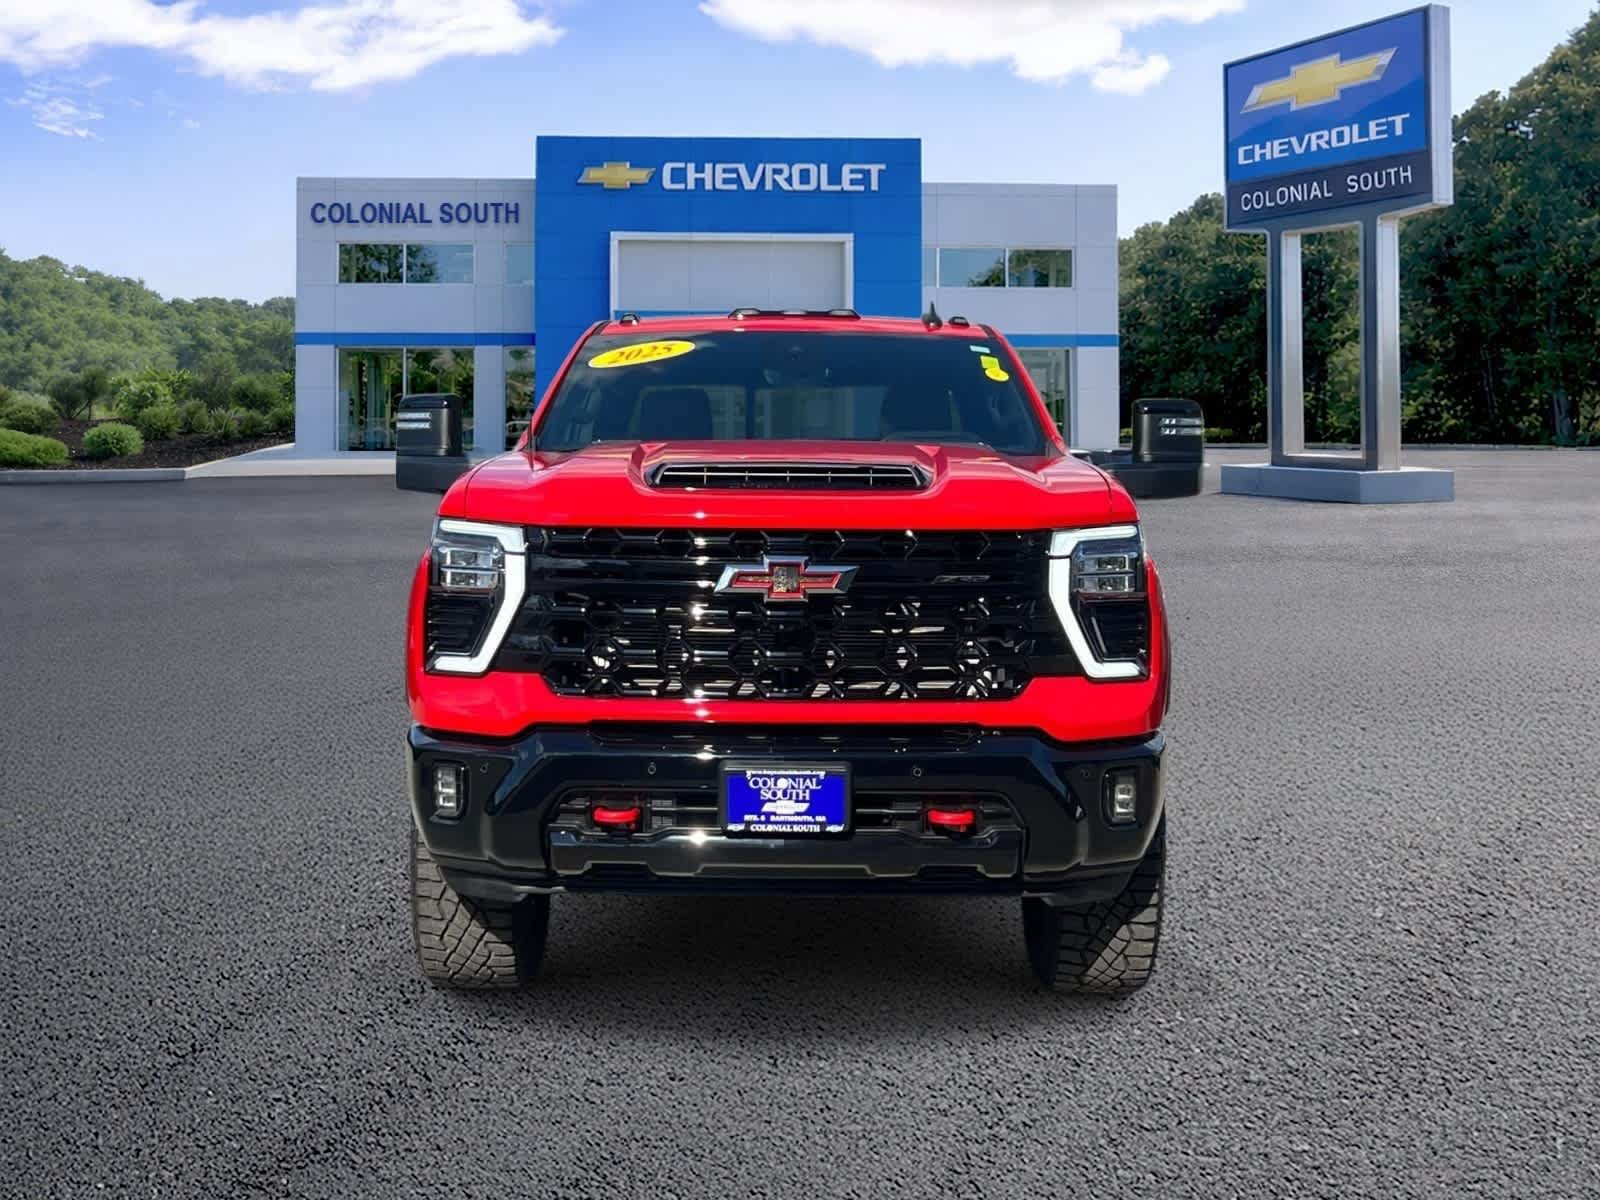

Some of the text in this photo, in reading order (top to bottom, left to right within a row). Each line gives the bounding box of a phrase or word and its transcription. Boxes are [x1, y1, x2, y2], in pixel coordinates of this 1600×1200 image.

[1237, 113, 1410, 165] CHEVROLET
[662, 162, 887, 192] CHEVROLET
[1241, 165, 1412, 211] COLONIAL SOUTH
[310, 202, 520, 224] COLONIAL SOUTH
[607, 343, 674, 365] 2025
[749, 777, 821, 790] COLONIAL
[760, 789, 810, 801] SOUTH
[750, 824, 821, 833] COLONIAL SOUTH
